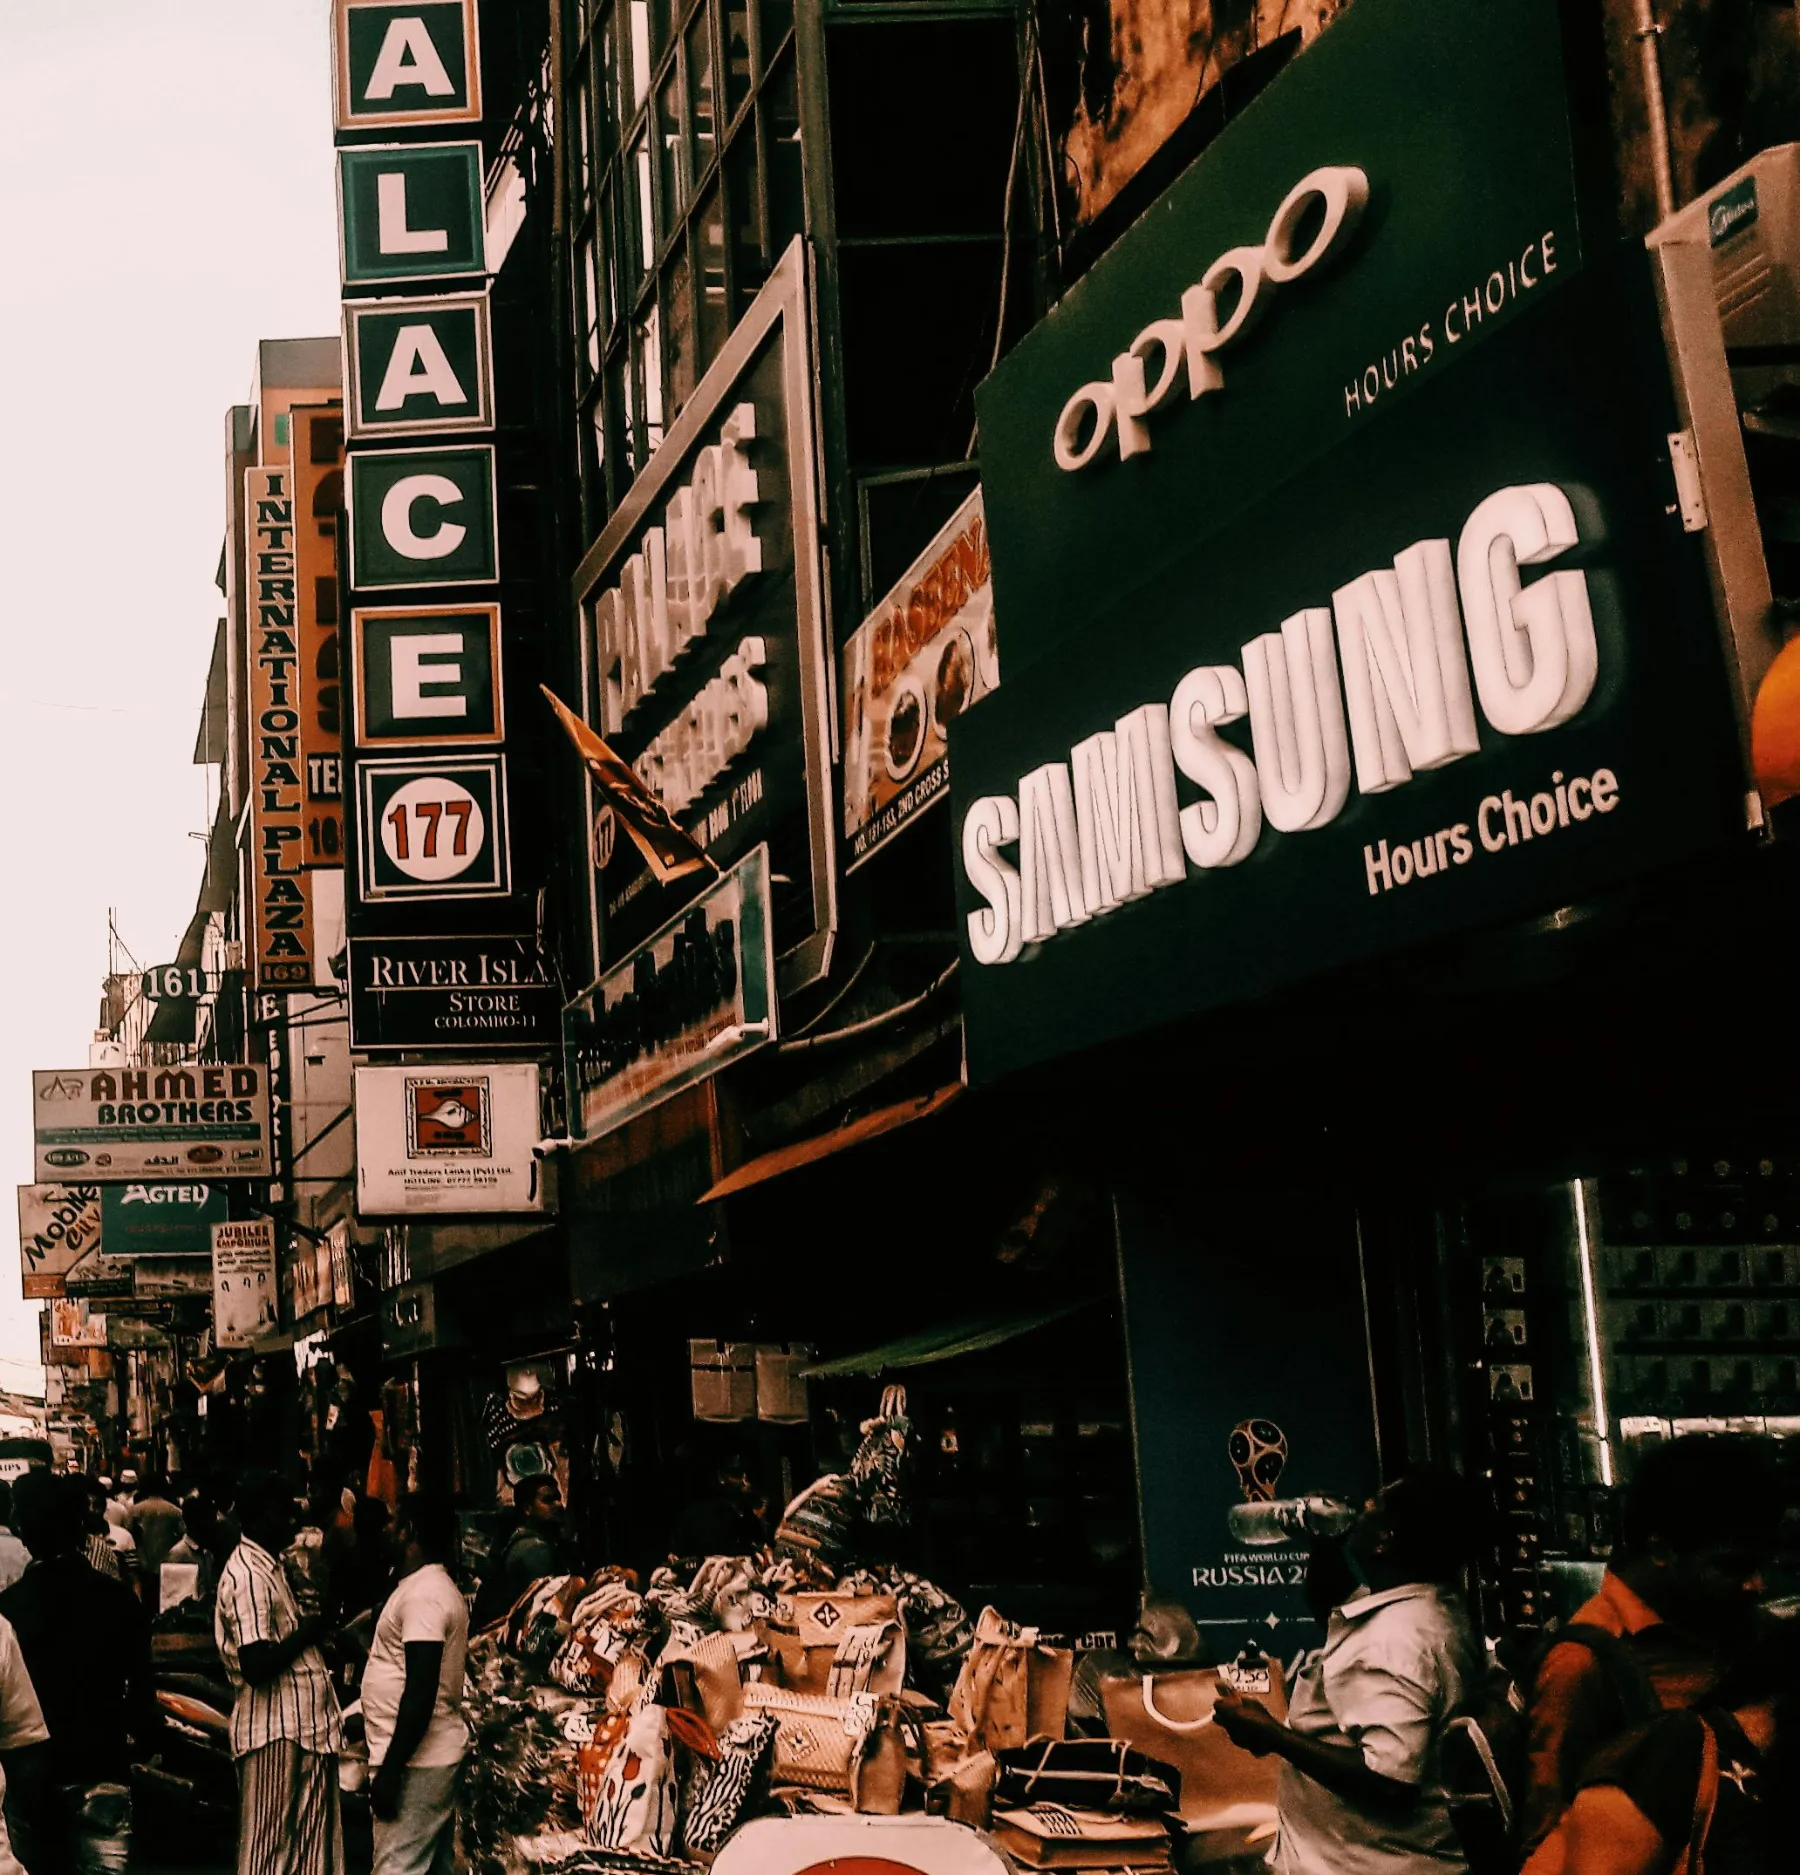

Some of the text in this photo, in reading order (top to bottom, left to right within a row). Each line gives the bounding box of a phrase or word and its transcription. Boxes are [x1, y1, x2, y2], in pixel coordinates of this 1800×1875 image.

[1344, 229, 1560, 418] HOURS CHOICE
[364, 16, 468, 719] ALACE
[256, 474, 306, 957] INTERNATIONAL PLAZA
[962, 482, 1598, 965] SAMSUNG
[915, 766, 941, 805] CROSS
[388, 800, 473, 860] 177
[1364, 767, 1621, 896] Hours Choice
[148, 967, 201, 998] 161
[372, 955, 468, 987] RIVER
[450, 992, 521, 1012] STORE
[91, 1069, 258, 1101] AHMED
[98, 1100, 253, 1125] BROTHERS
[25, 1184, 98, 1272] Mobile
[217, 1238, 271, 1248] EMPORIUM
[218, 1225, 269, 1238] JUBILEE
[1224, 1553, 1248, 1563] FIFA
[1249, 1552, 1288, 1563] WORLD
[1192, 1565, 1285, 1587] RUSSIA
